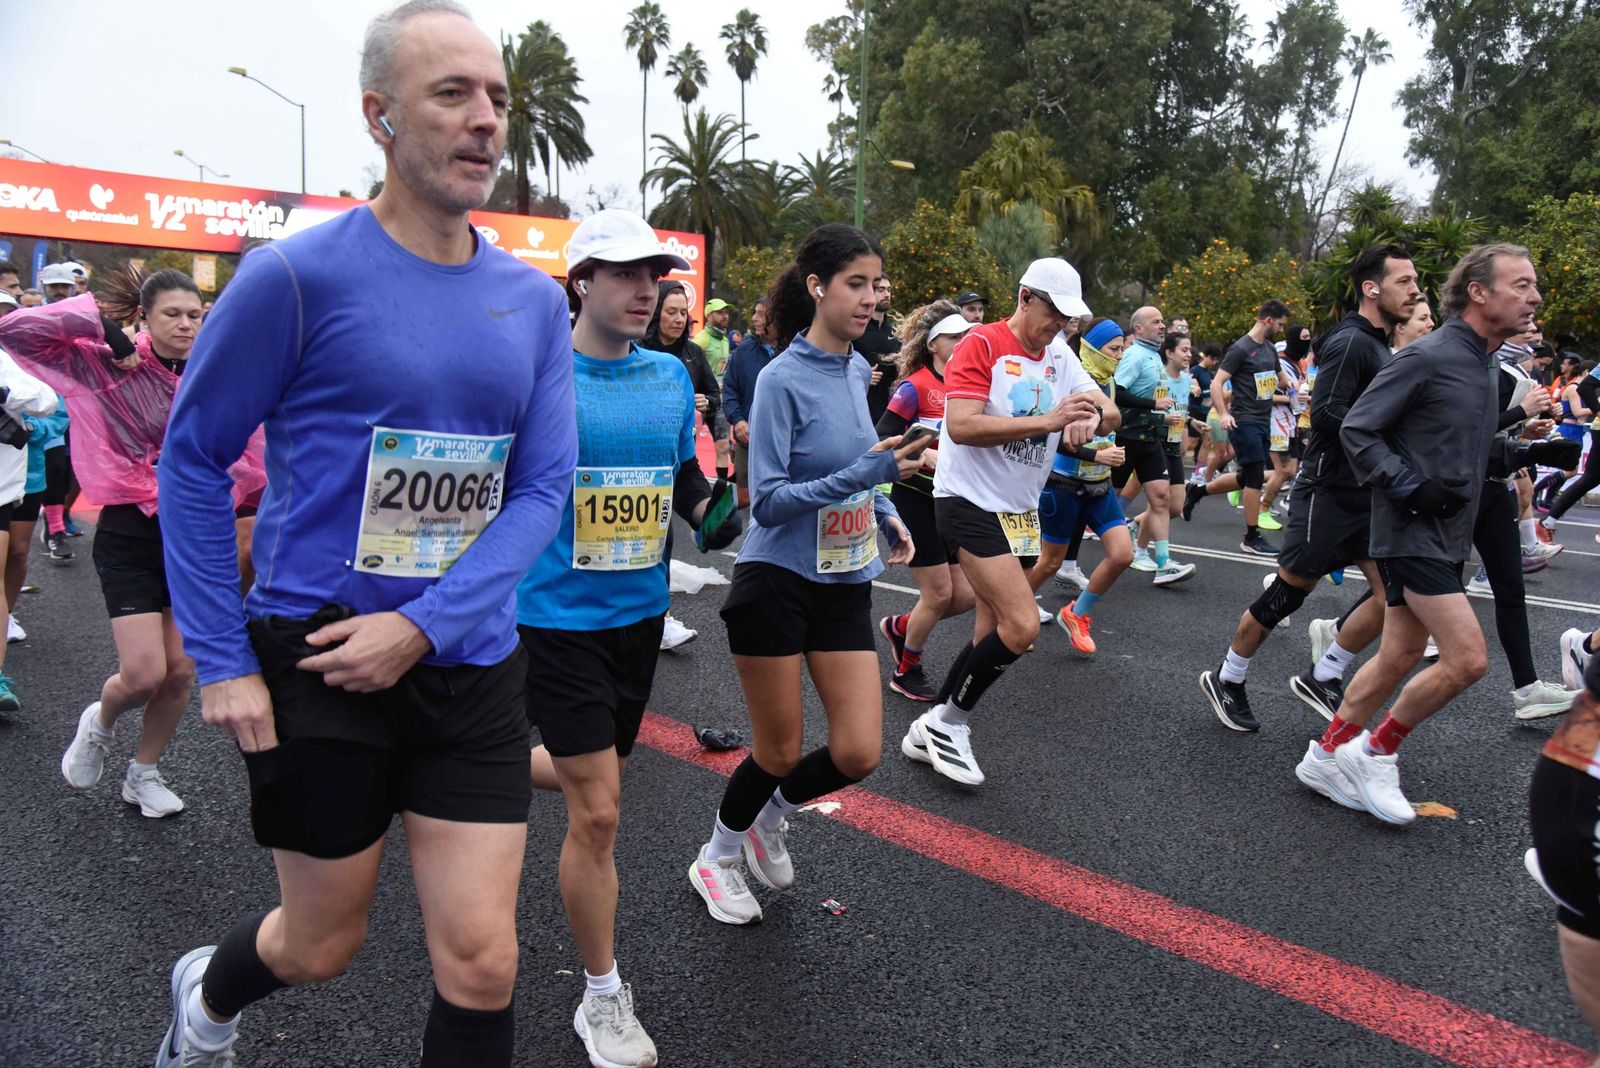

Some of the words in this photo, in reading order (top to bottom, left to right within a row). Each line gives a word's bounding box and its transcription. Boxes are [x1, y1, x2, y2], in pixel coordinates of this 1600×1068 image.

[182, 197, 283, 225] maratón
[430, 438, 486, 452] maratón
[444, 449, 484, 461] sevilla
[613, 471, 650, 480] maratón
[378, 468, 494, 512] 20066
[370, 486, 382, 515] CAJÓN
[585, 493, 660, 524] 15901
[394, 527, 418, 537] Angel
[415, 561, 437, 569] HOKA
